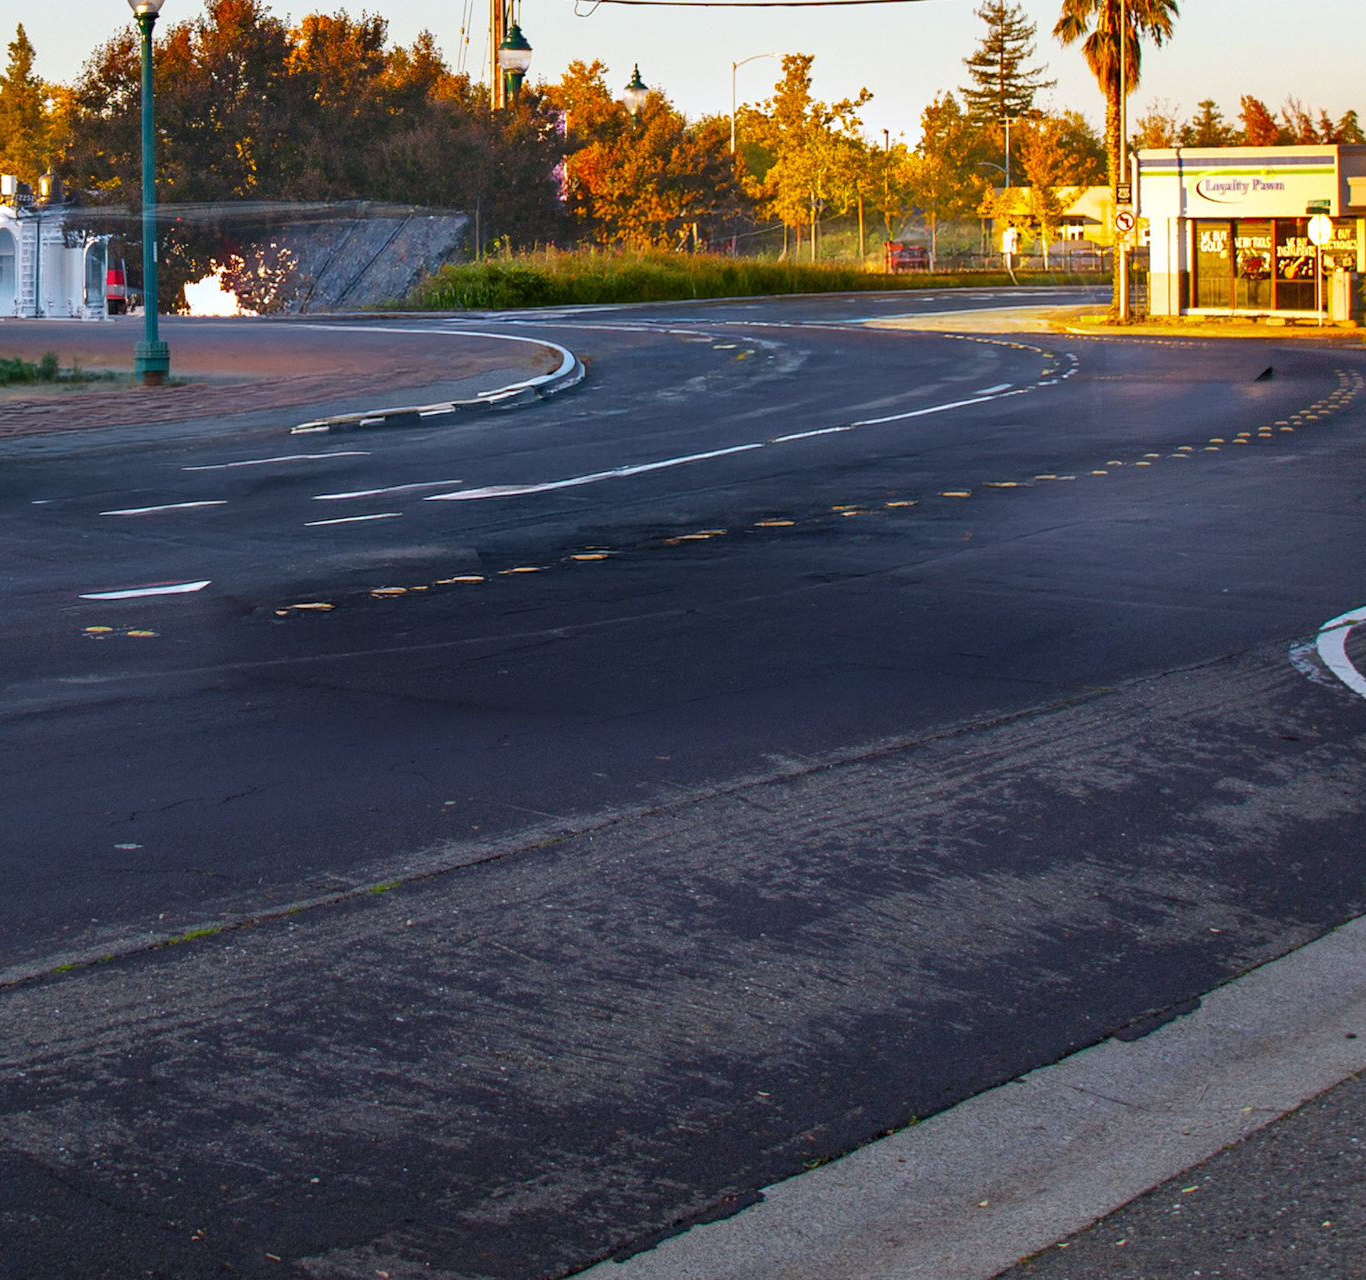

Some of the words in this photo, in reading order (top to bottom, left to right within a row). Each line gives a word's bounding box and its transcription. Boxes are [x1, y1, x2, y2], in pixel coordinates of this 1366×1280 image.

[1205, 179, 1249, 195] Loyalty
[1252, 179, 1284, 191] Pawn
[1200, 240, 1224, 252] GOLD
